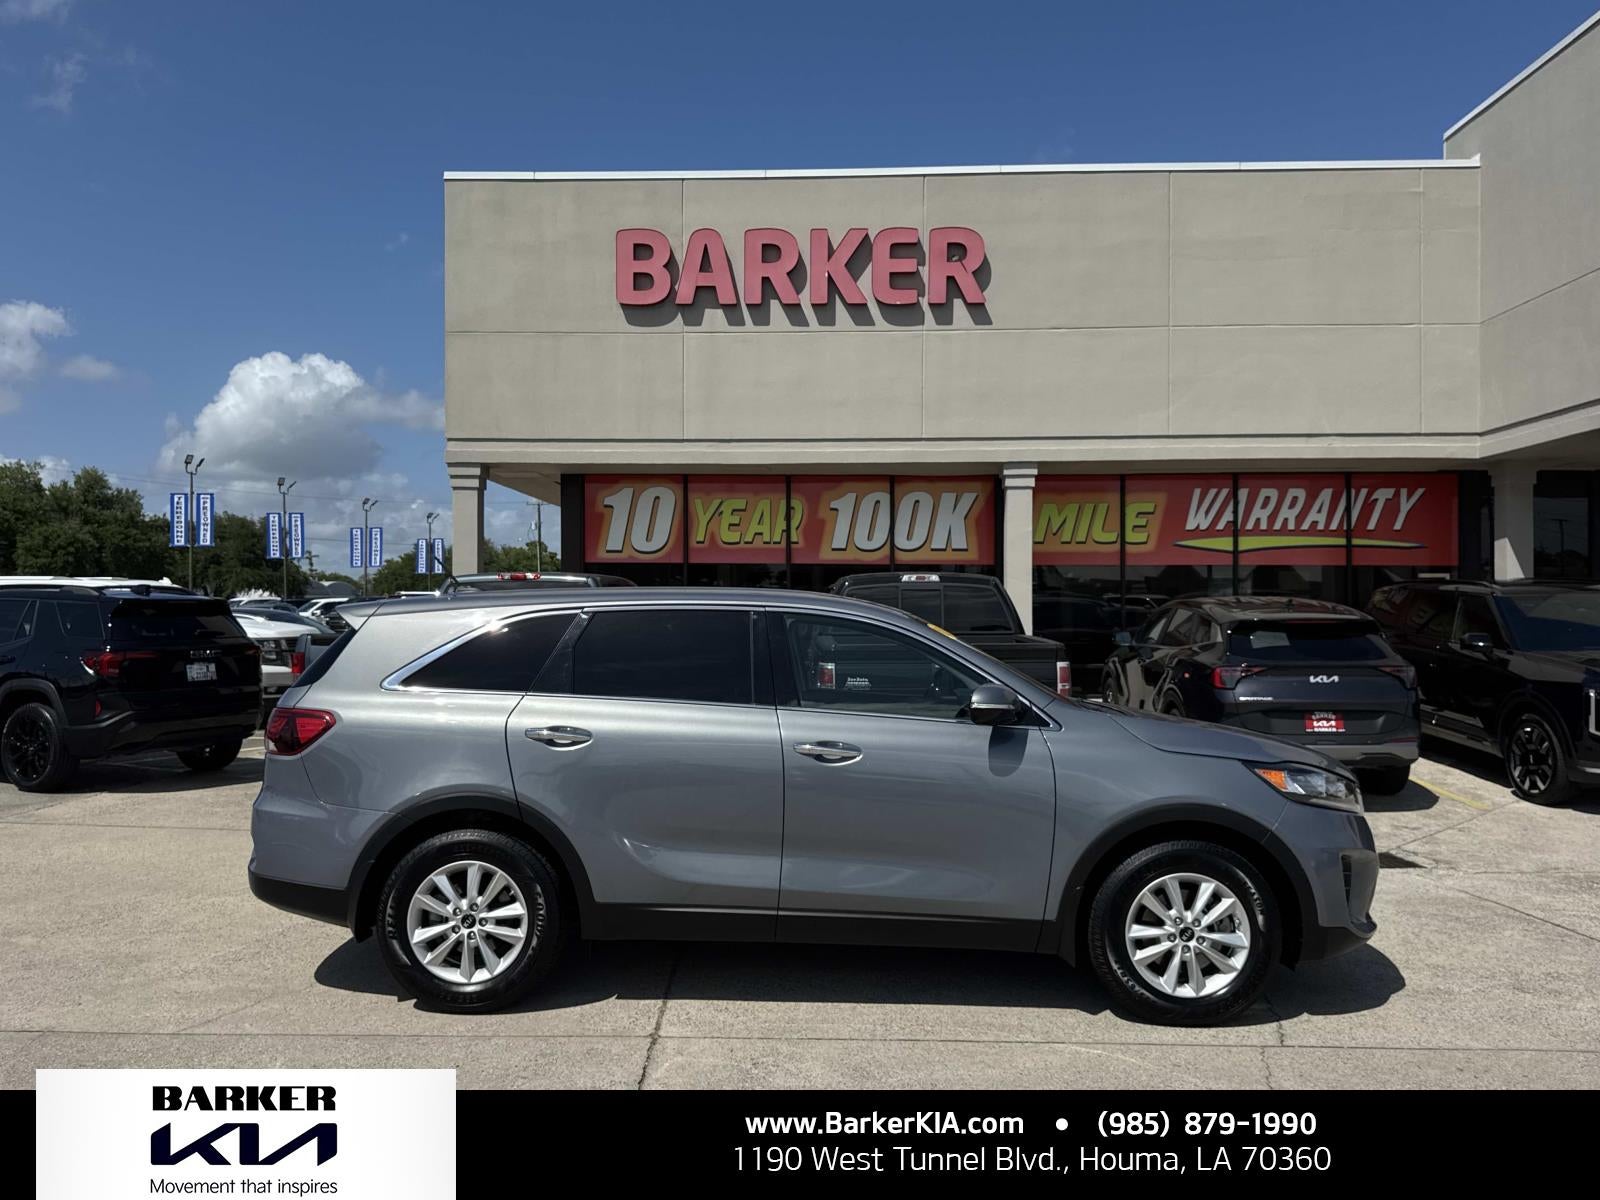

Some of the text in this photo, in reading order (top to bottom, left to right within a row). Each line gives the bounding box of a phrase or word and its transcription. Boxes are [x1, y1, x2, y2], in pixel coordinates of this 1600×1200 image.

[615, 227, 987, 306] BARKER
[603, 486, 1426, 554] 10 YEAR 100K MILE WARRANTY
[1309, 675, 1340, 683] KIA
